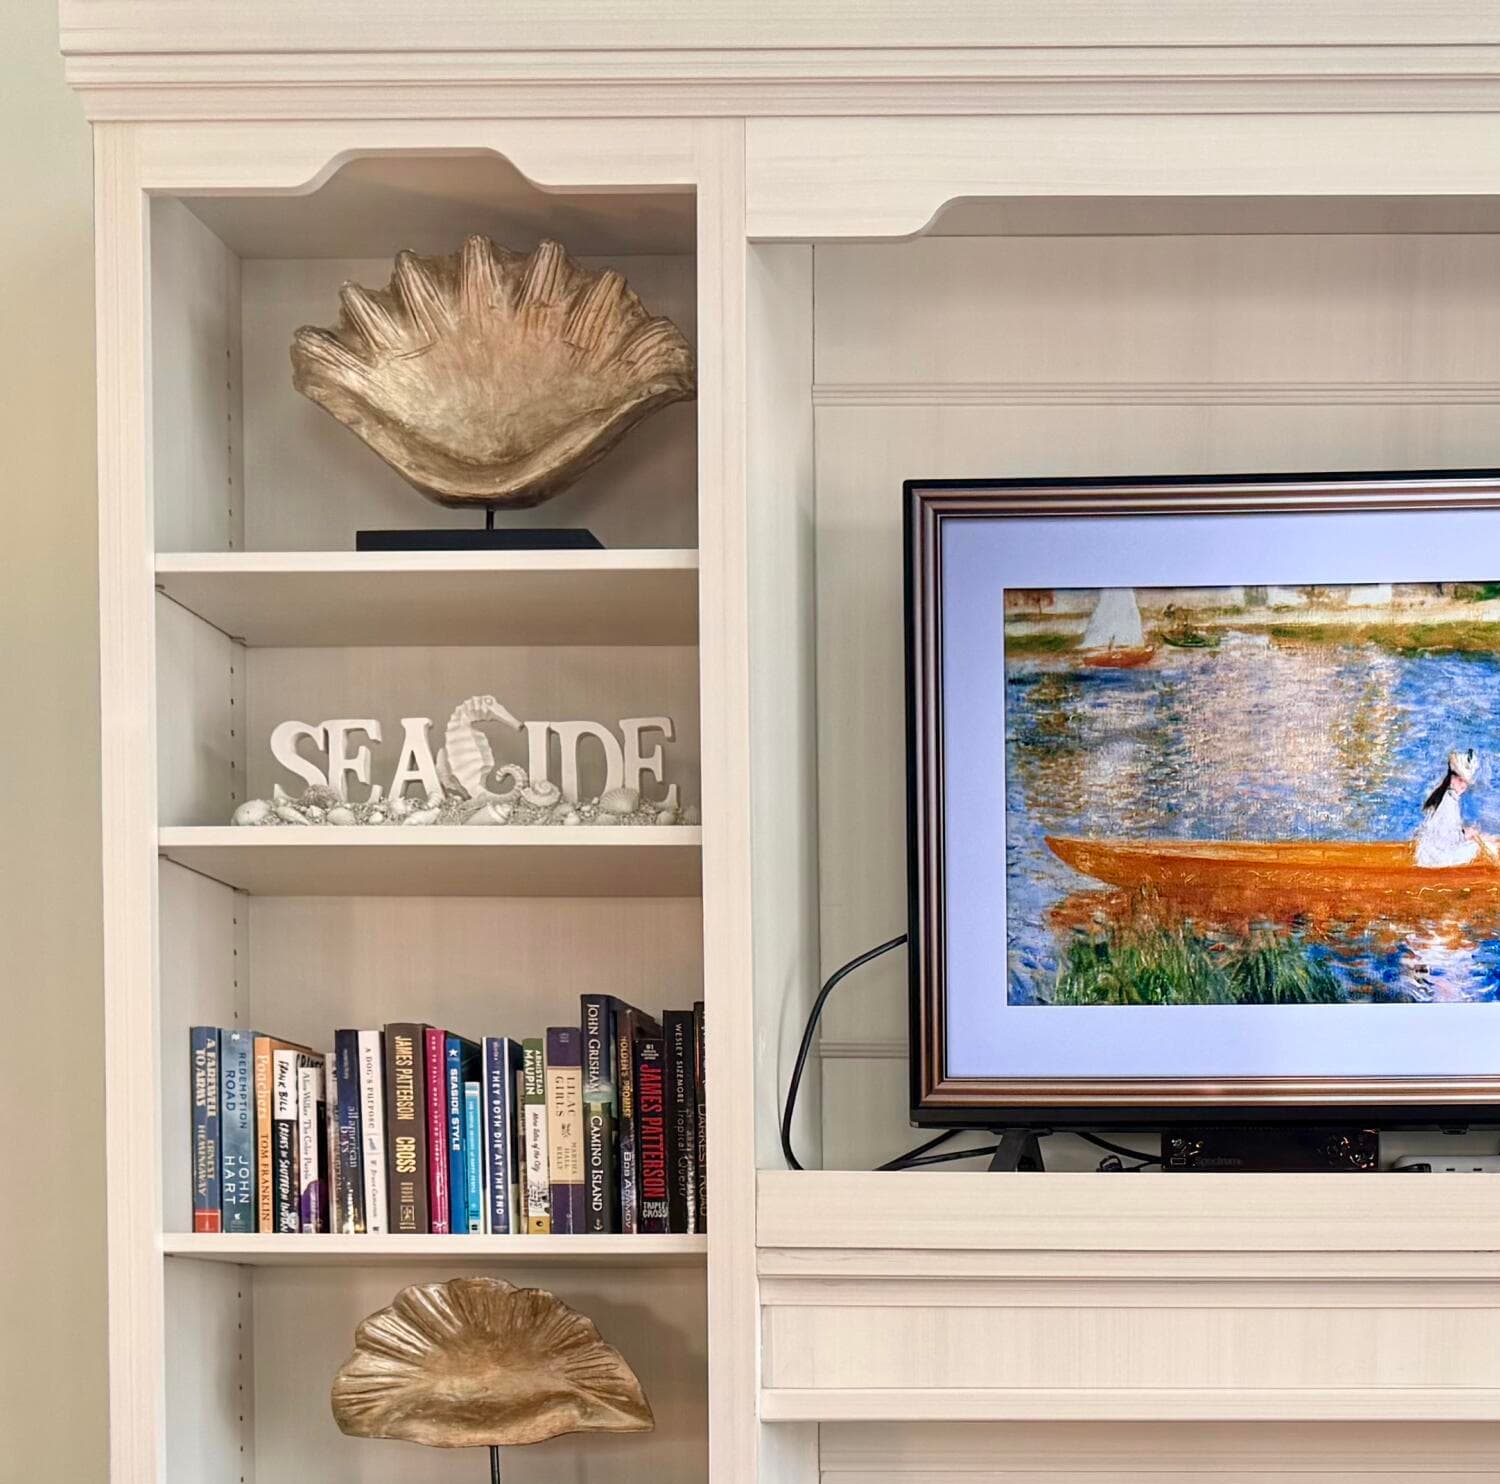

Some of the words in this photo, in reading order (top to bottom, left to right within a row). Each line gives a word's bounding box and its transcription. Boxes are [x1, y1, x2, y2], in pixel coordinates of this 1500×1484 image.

[587, 1004, 600, 1035] JOHN
[196, 1049, 206, 1066] TO
[206, 1038, 216, 1048] A
[395, 1035, 413, 1066] JAMES
[620, 1036, 631, 1077] HOLDEN'S
[675, 1023, 683, 1058] WESLEY
[207, 1051, 217, 1117] FAREWELL
[277, 1060, 289, 1088] FRANK
[492, 1069, 500, 1096] THEY
[524, 1049, 535, 1096] MAUPIN
[535, 1050, 543, 1095] ARMISTEAD
[588, 1038, 602, 1093] GRISHAM
[676, 1060, 684, 1104] SIZEMORE
[196, 1067, 207, 1107] ARMS
[225, 1069, 236, 1112] ROAD
[238, 1052, 248, 1130] REDEMPTION
[256, 1055, 266, 1119] Poachers
[278, 1090, 288, 1114] BILL
[395, 1067, 415, 1121] PATTERSON
[450, 1068, 459, 1114] SEASIDE
[555, 1076, 566, 1118] GIRLS
[566, 1076, 577, 1117] LILAC
[639, 1063, 662, 1113] JAMES
[303, 1119, 312, 1135] The
[492, 1098, 502, 1128] BOTH
[260, 1133, 269, 1159] TOM
[304, 1135, 312, 1156] Color
[452, 1117, 460, 1151] STYLE
[494, 1131, 502, 1149] DIE
[590, 1115, 603, 1167] CAMINO
[198, 1124, 209, 1197] HEMINGWAY
[207, 1139, 216, 1180] ERNEST
[301, 1157, 312, 1181] Purple
[395, 1136, 417, 1174] CROSS
[495, 1153, 503, 1166] AT
[623, 1151, 633, 1177] BOB
[642, 1116, 666, 1199] PATTERSON
[223, 1155, 236, 1205] HART
[239, 1155, 250, 1204] JOHN
[260, 1162, 271, 1222] FRANKLIN
[495, 1172, 504, 1190] THE
[592, 1169, 604, 1212] ISLAND
[495, 1194, 505, 1215] END
